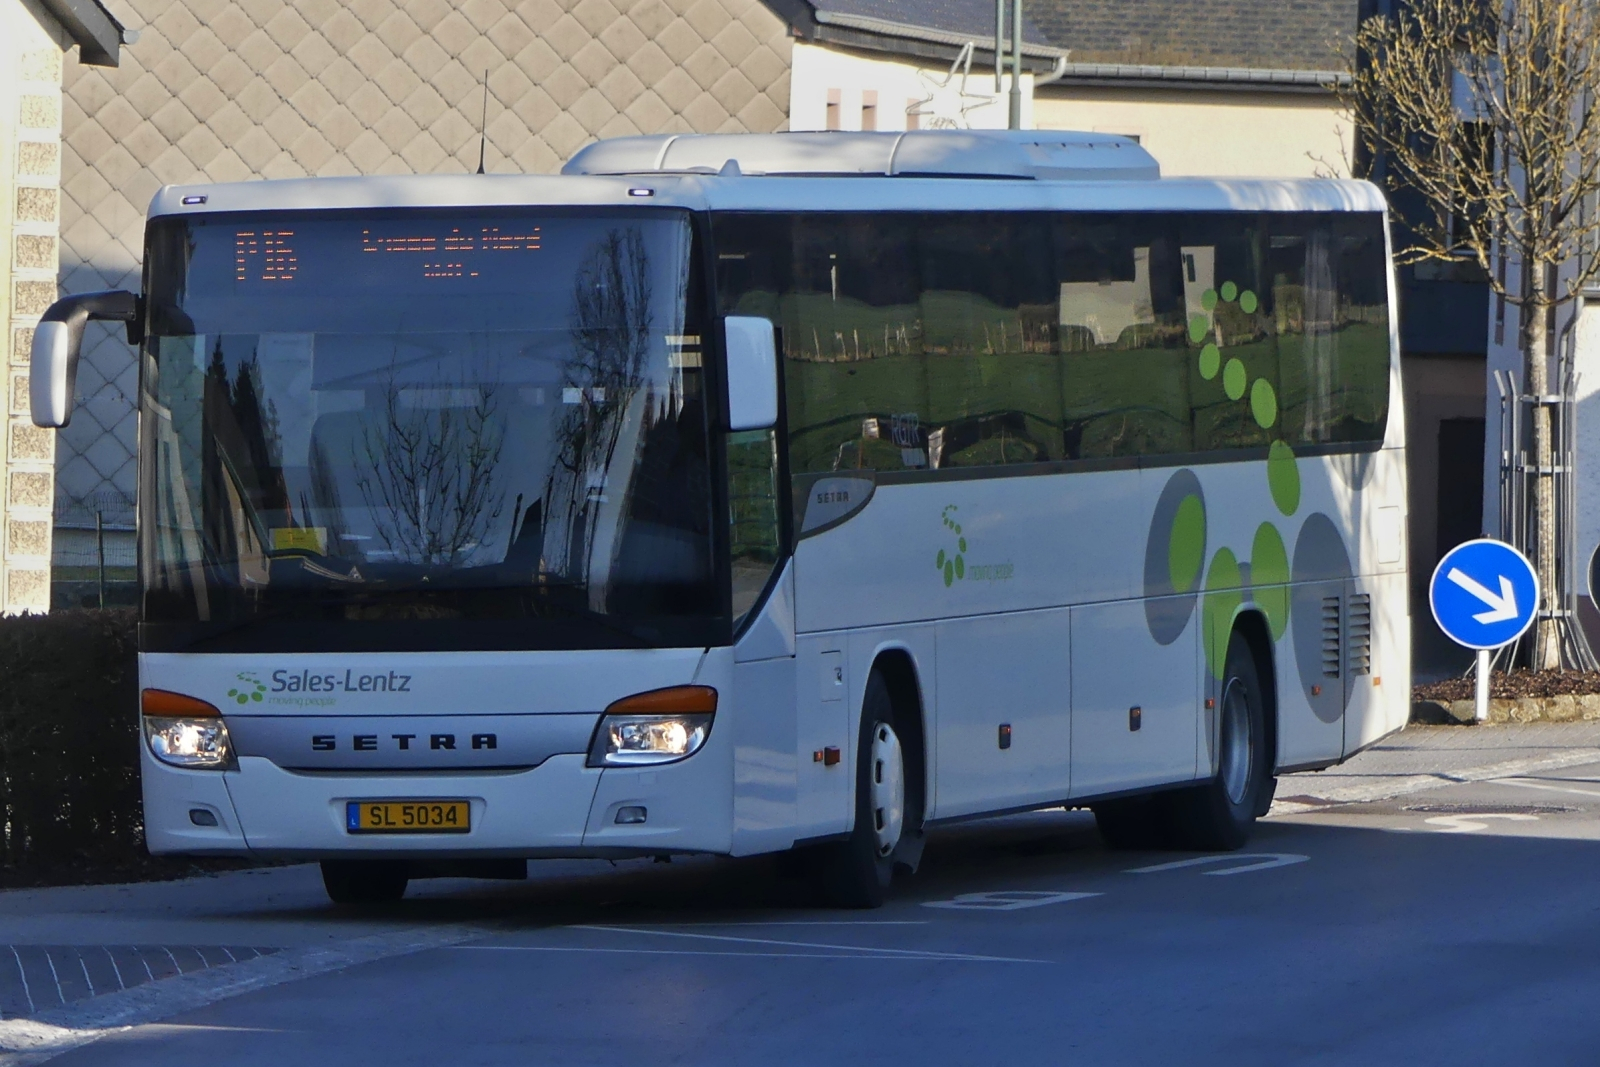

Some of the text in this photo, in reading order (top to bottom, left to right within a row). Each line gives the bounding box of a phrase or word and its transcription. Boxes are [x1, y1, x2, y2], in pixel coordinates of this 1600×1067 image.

[817, 491, 849, 504] SETRA
[271, 668, 412, 693] Sales-Lentz
[268, 696, 337, 709] moving people
[312, 733, 498, 751] SETRA
[370, 805, 397, 826] SL
[402, 805, 458, 826] 5034
